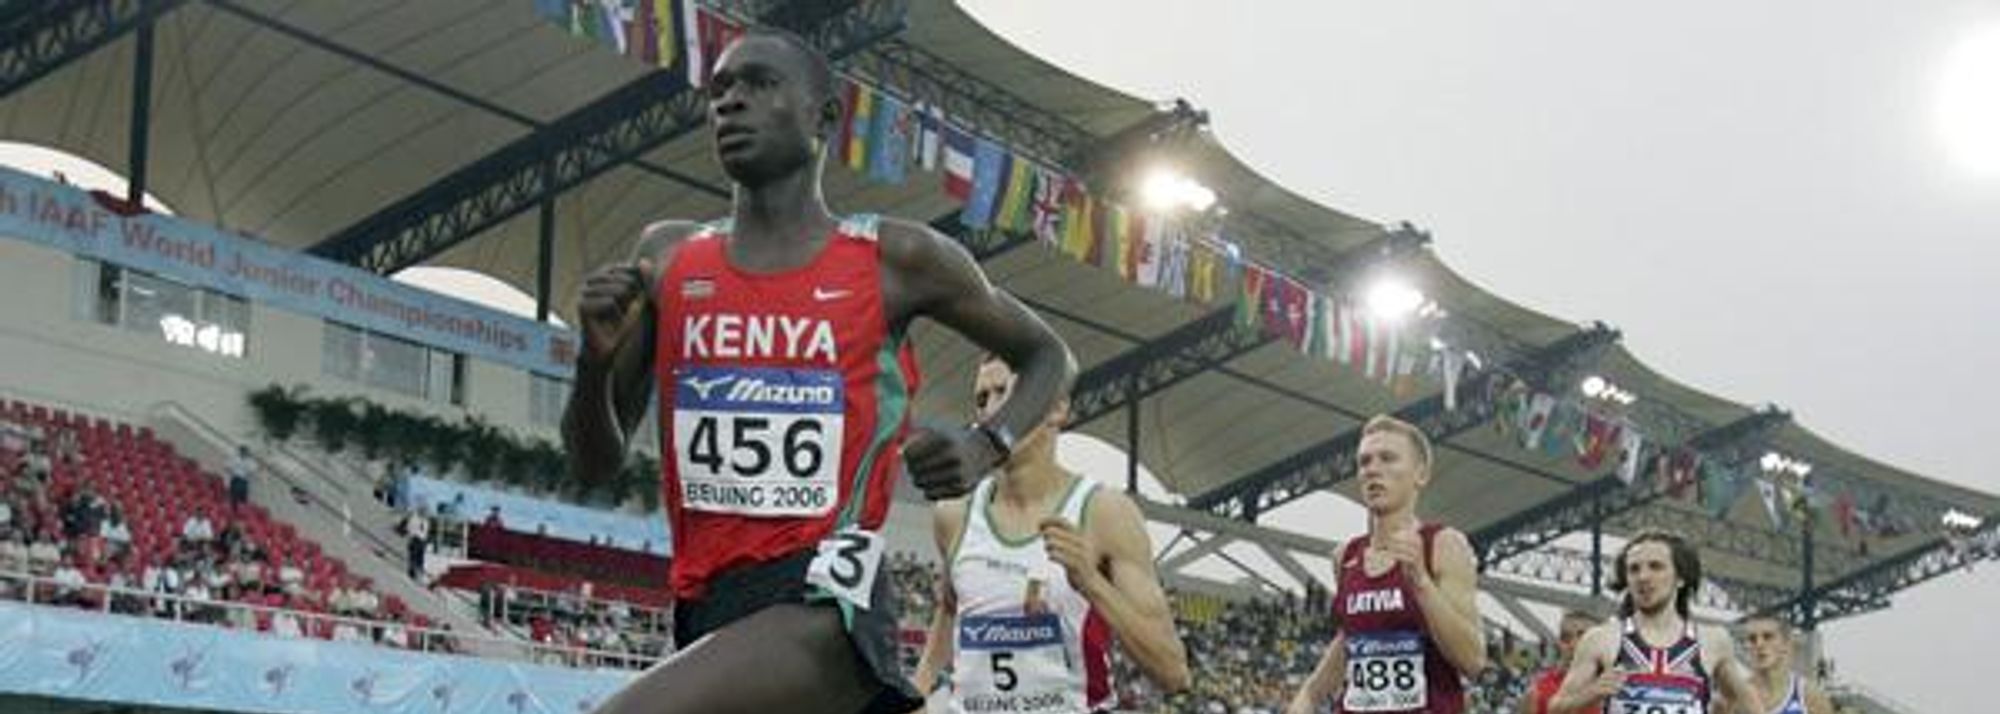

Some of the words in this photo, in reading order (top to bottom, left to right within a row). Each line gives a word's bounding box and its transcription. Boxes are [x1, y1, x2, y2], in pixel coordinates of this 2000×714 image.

[29, 188, 107, 238] IAAF
[119, 219, 216, 267] World
[222, 252, 320, 296] Junior
[328, 276, 527, 350] Championships
[683, 314, 838, 363] KENYA
[688, 416, 823, 478] 456
[686, 483, 764, 505] BEIJING
[773, 486, 827, 506] 2006
[829, 533, 871, 588] 3
[1346, 588, 1405, 615] LATVIA
[990, 652, 1018, 691] 5
